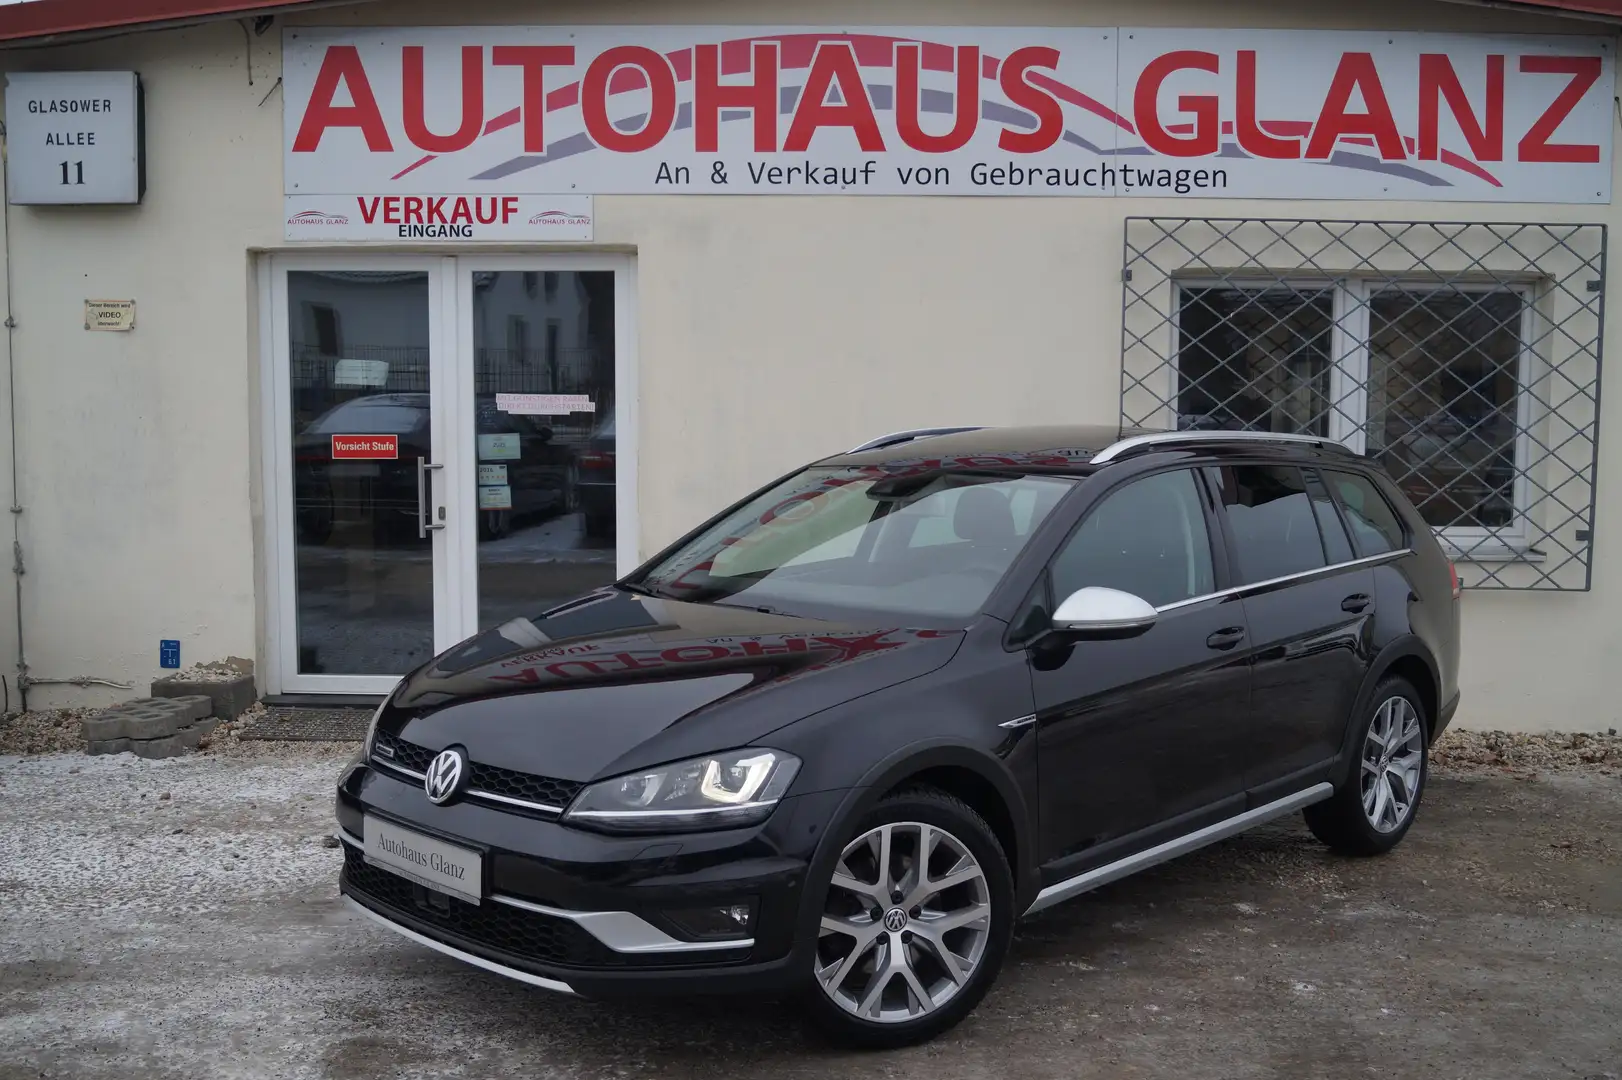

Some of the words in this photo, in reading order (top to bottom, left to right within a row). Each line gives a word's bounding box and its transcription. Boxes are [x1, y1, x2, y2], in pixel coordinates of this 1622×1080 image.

[28, 99, 111, 113] GLASOWER
[291, 43, 1064, 154] AUTOHAUS
[1133, 50, 1602, 163] GLANZ
[46, 132, 95, 146] ALLEE
[59, 160, 85, 185] 11
[655, 162, 690, 185] An
[710, 162, 728, 185] &
[748, 161, 877, 186] Verkauf
[896, 167, 949, 186] von
[970, 161, 1228, 194] Gebrauchtwagen
[357, 197, 518, 224] VERKAUF
[398, 224, 473, 238] EINGANG
[335, 441, 370, 451] Vorsicht
[372, 441, 395, 451] Stufe
[378, 832, 428, 867] Autohaus
[430, 852, 465, 881] Glanz
